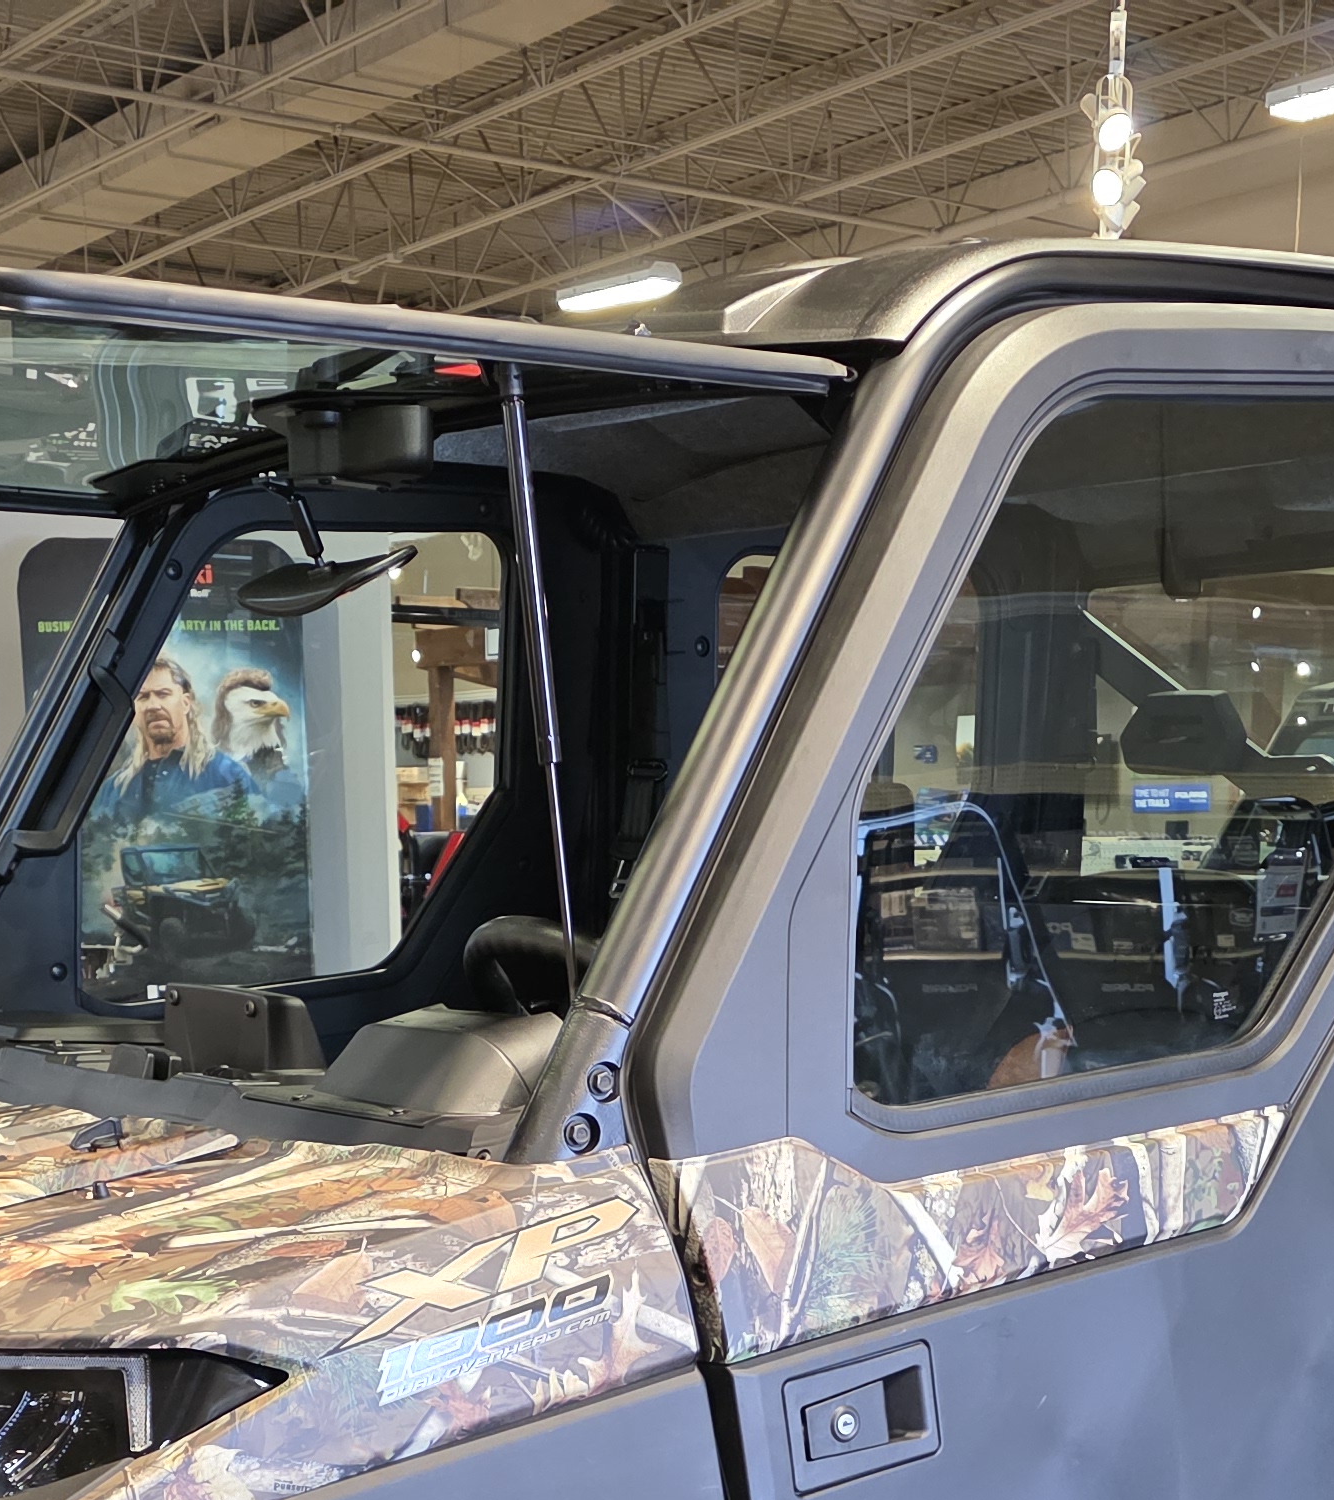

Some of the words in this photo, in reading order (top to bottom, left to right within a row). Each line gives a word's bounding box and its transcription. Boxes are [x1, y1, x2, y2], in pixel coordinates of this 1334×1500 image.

[209, 620, 221, 631] IN
[223, 620, 244, 631] THE
[318, 1195, 641, 1360] XP
[376, 1270, 615, 1393] 1000
[444, 1326, 561, 1379] OVERHEAD
[563, 1308, 612, 1337] CAM
